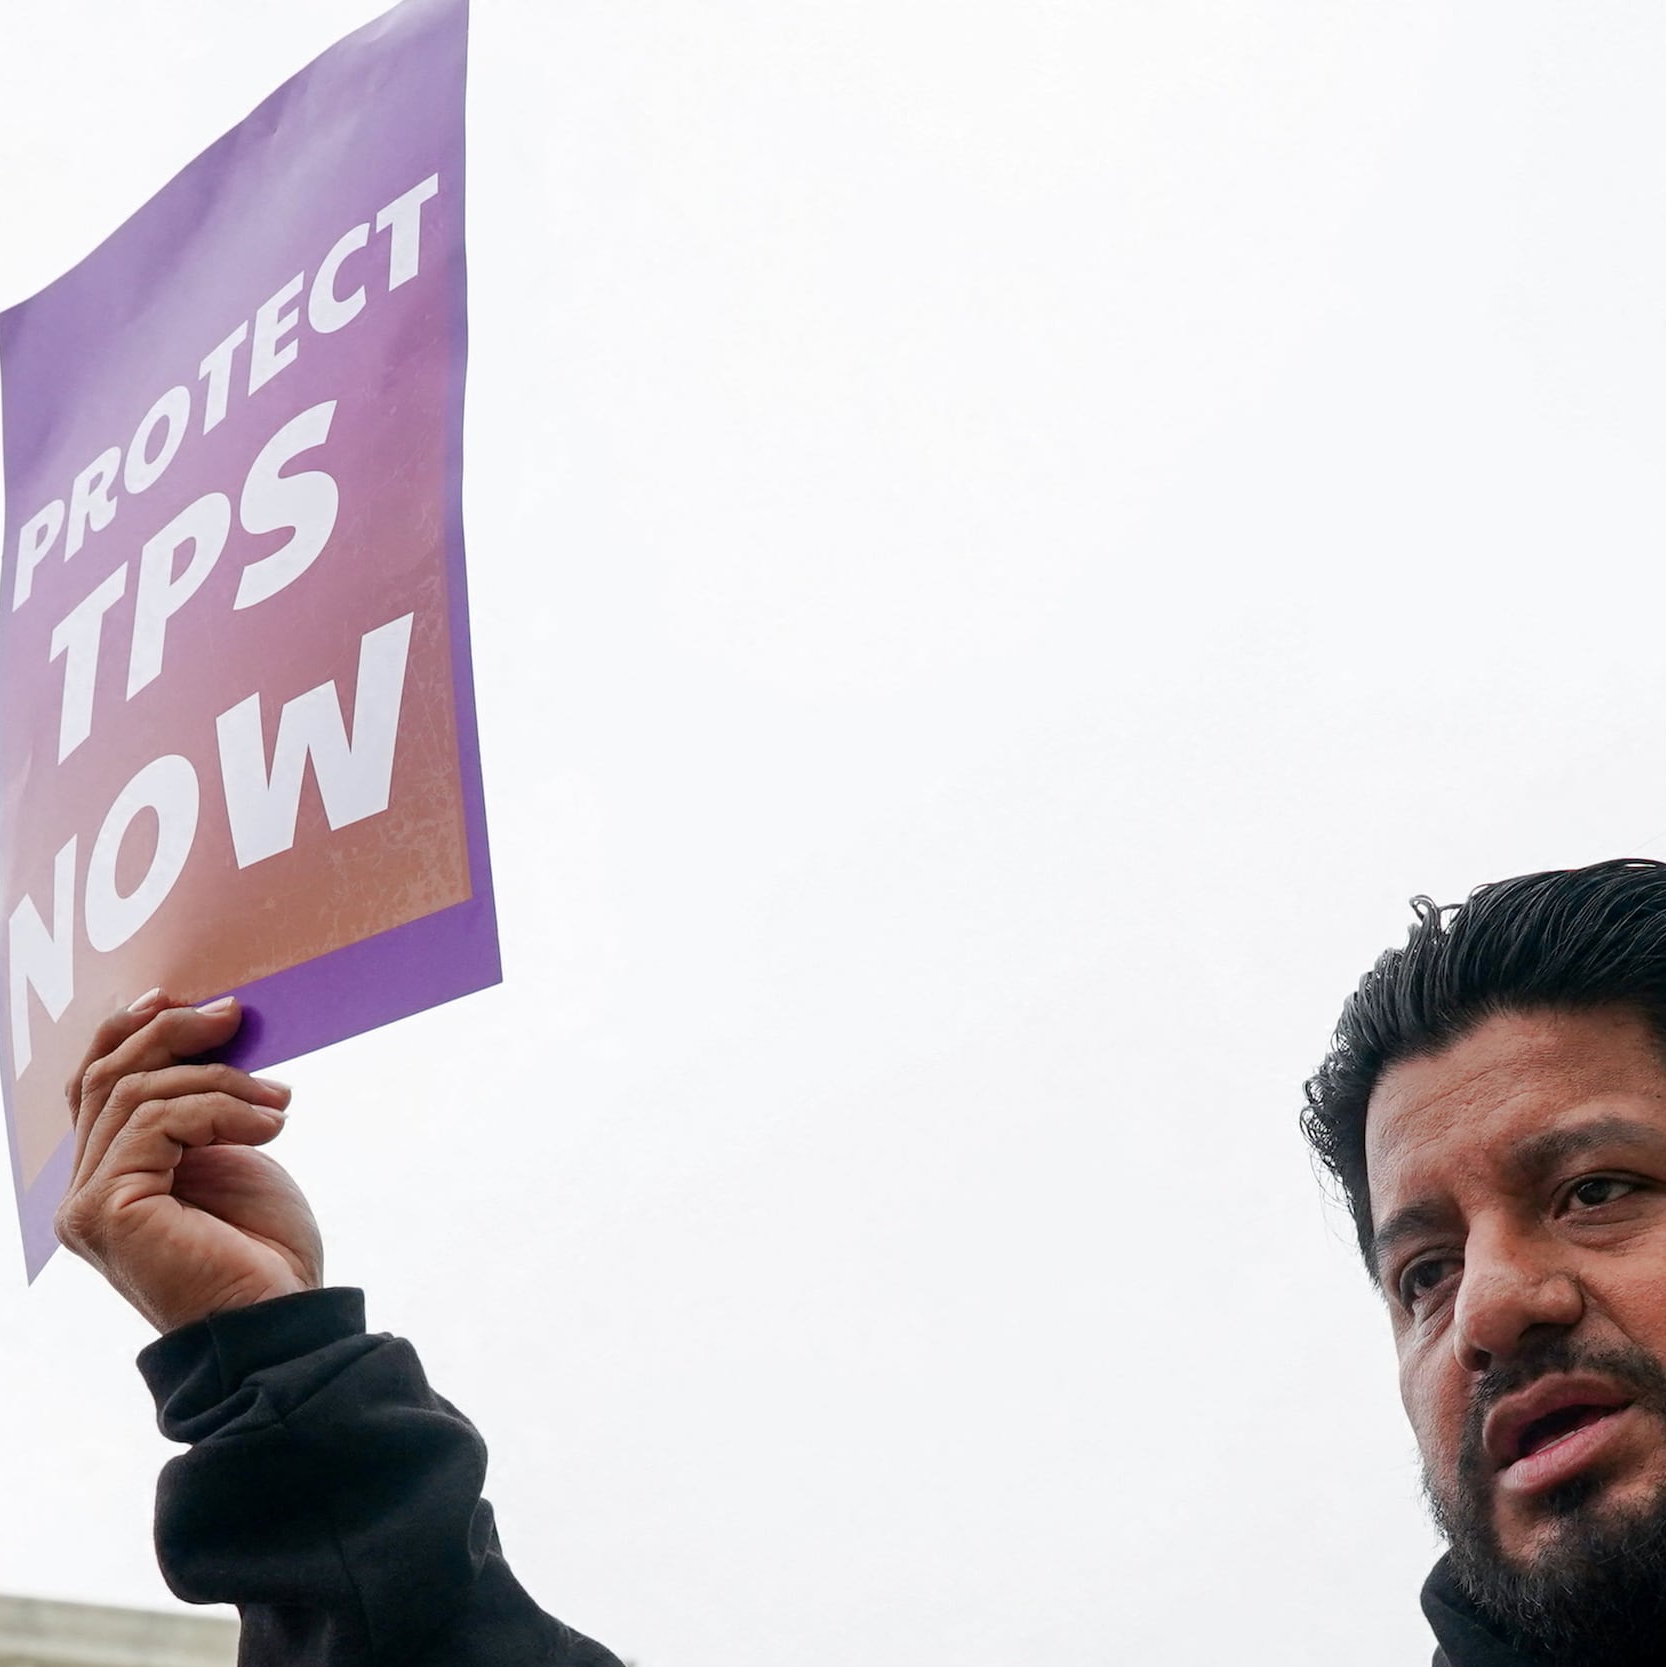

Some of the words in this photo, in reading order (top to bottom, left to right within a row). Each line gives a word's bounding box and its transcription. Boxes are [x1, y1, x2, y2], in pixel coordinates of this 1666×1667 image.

[12, 172, 439, 613] PROTECT
[48, 399, 339, 766] TPS
[8, 611, 415, 1081] NOW
